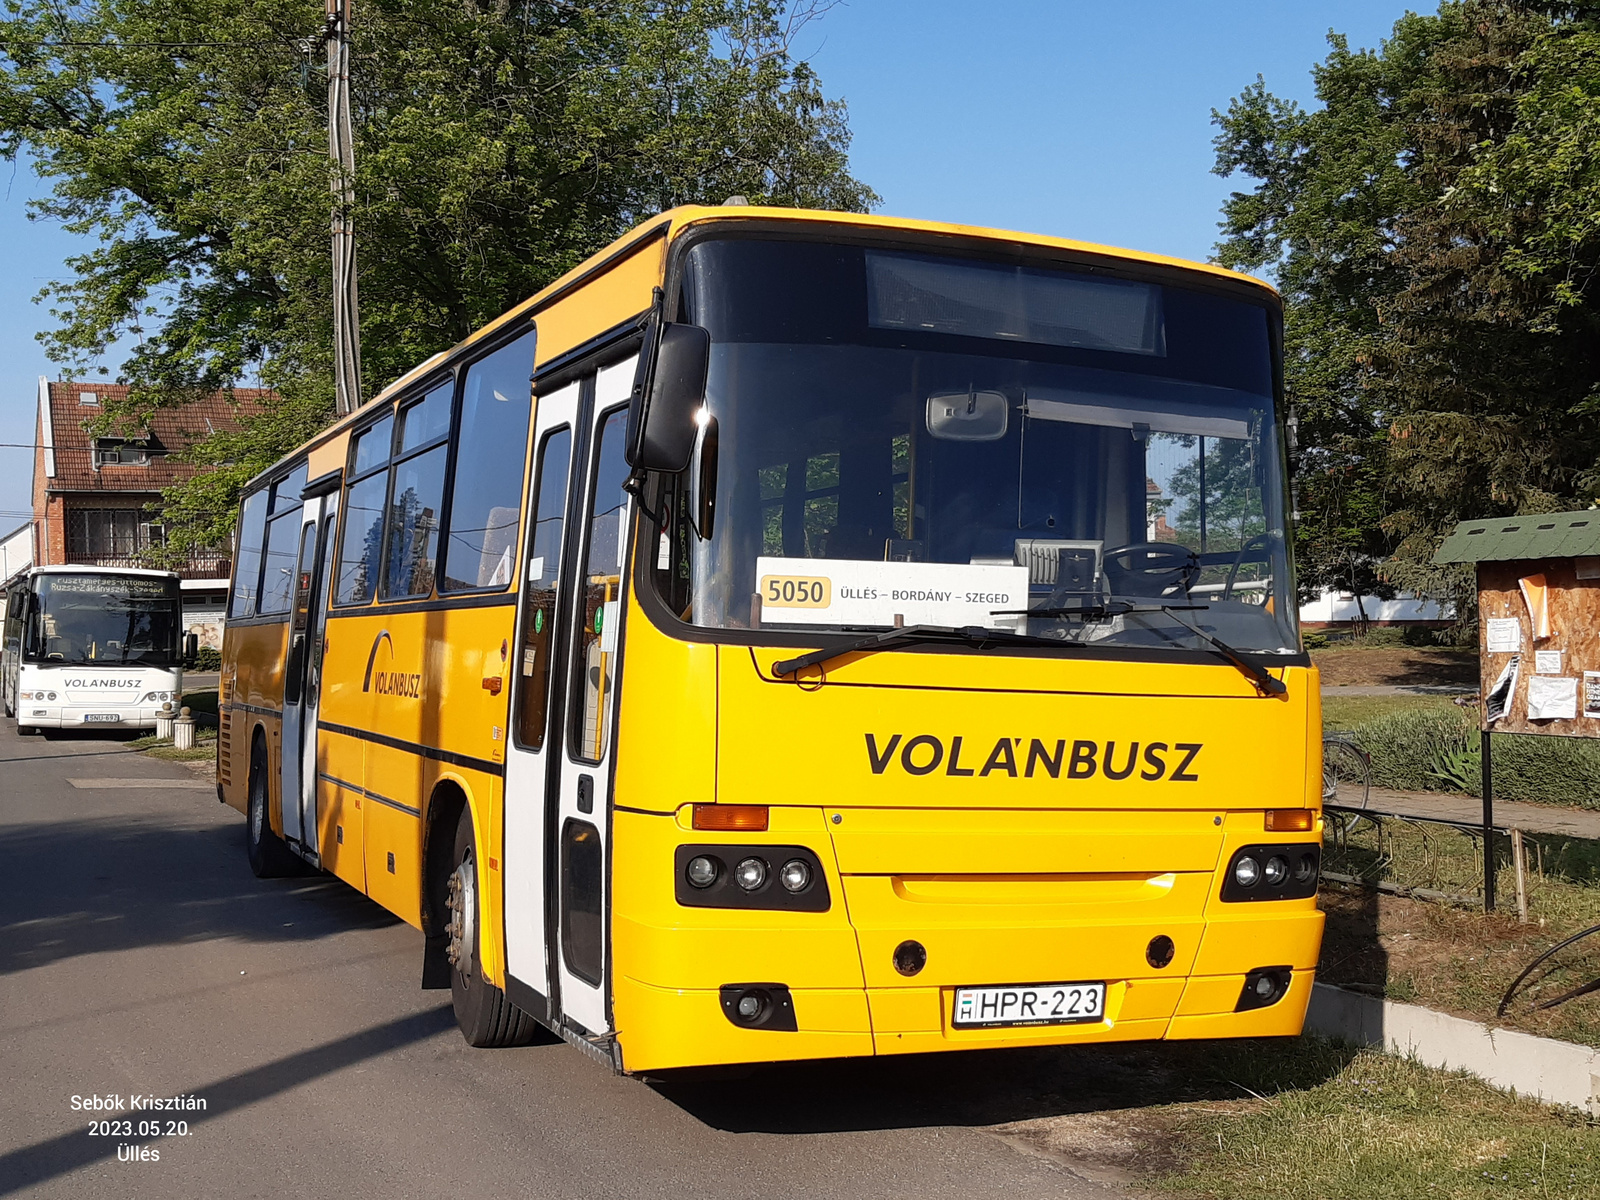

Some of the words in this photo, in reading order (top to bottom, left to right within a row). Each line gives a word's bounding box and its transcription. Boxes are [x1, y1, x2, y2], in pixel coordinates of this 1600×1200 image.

[768, 580, 824, 603] 5050
[840, 586, 877, 600] ÜLLÉS
[892, 588, 951, 602] BORDÁNY
[965, 592, 1009, 604] SZEGED
[64, 679, 142, 688] VOLÁNBUSZ
[375, 671, 421, 699] VOLÁNBUSZ
[864, 733, 1204, 782] VOLÁNBUSZ
[961, 1007, 972, 1019] H
[980, 988, 1098, 1018] HPR-223
